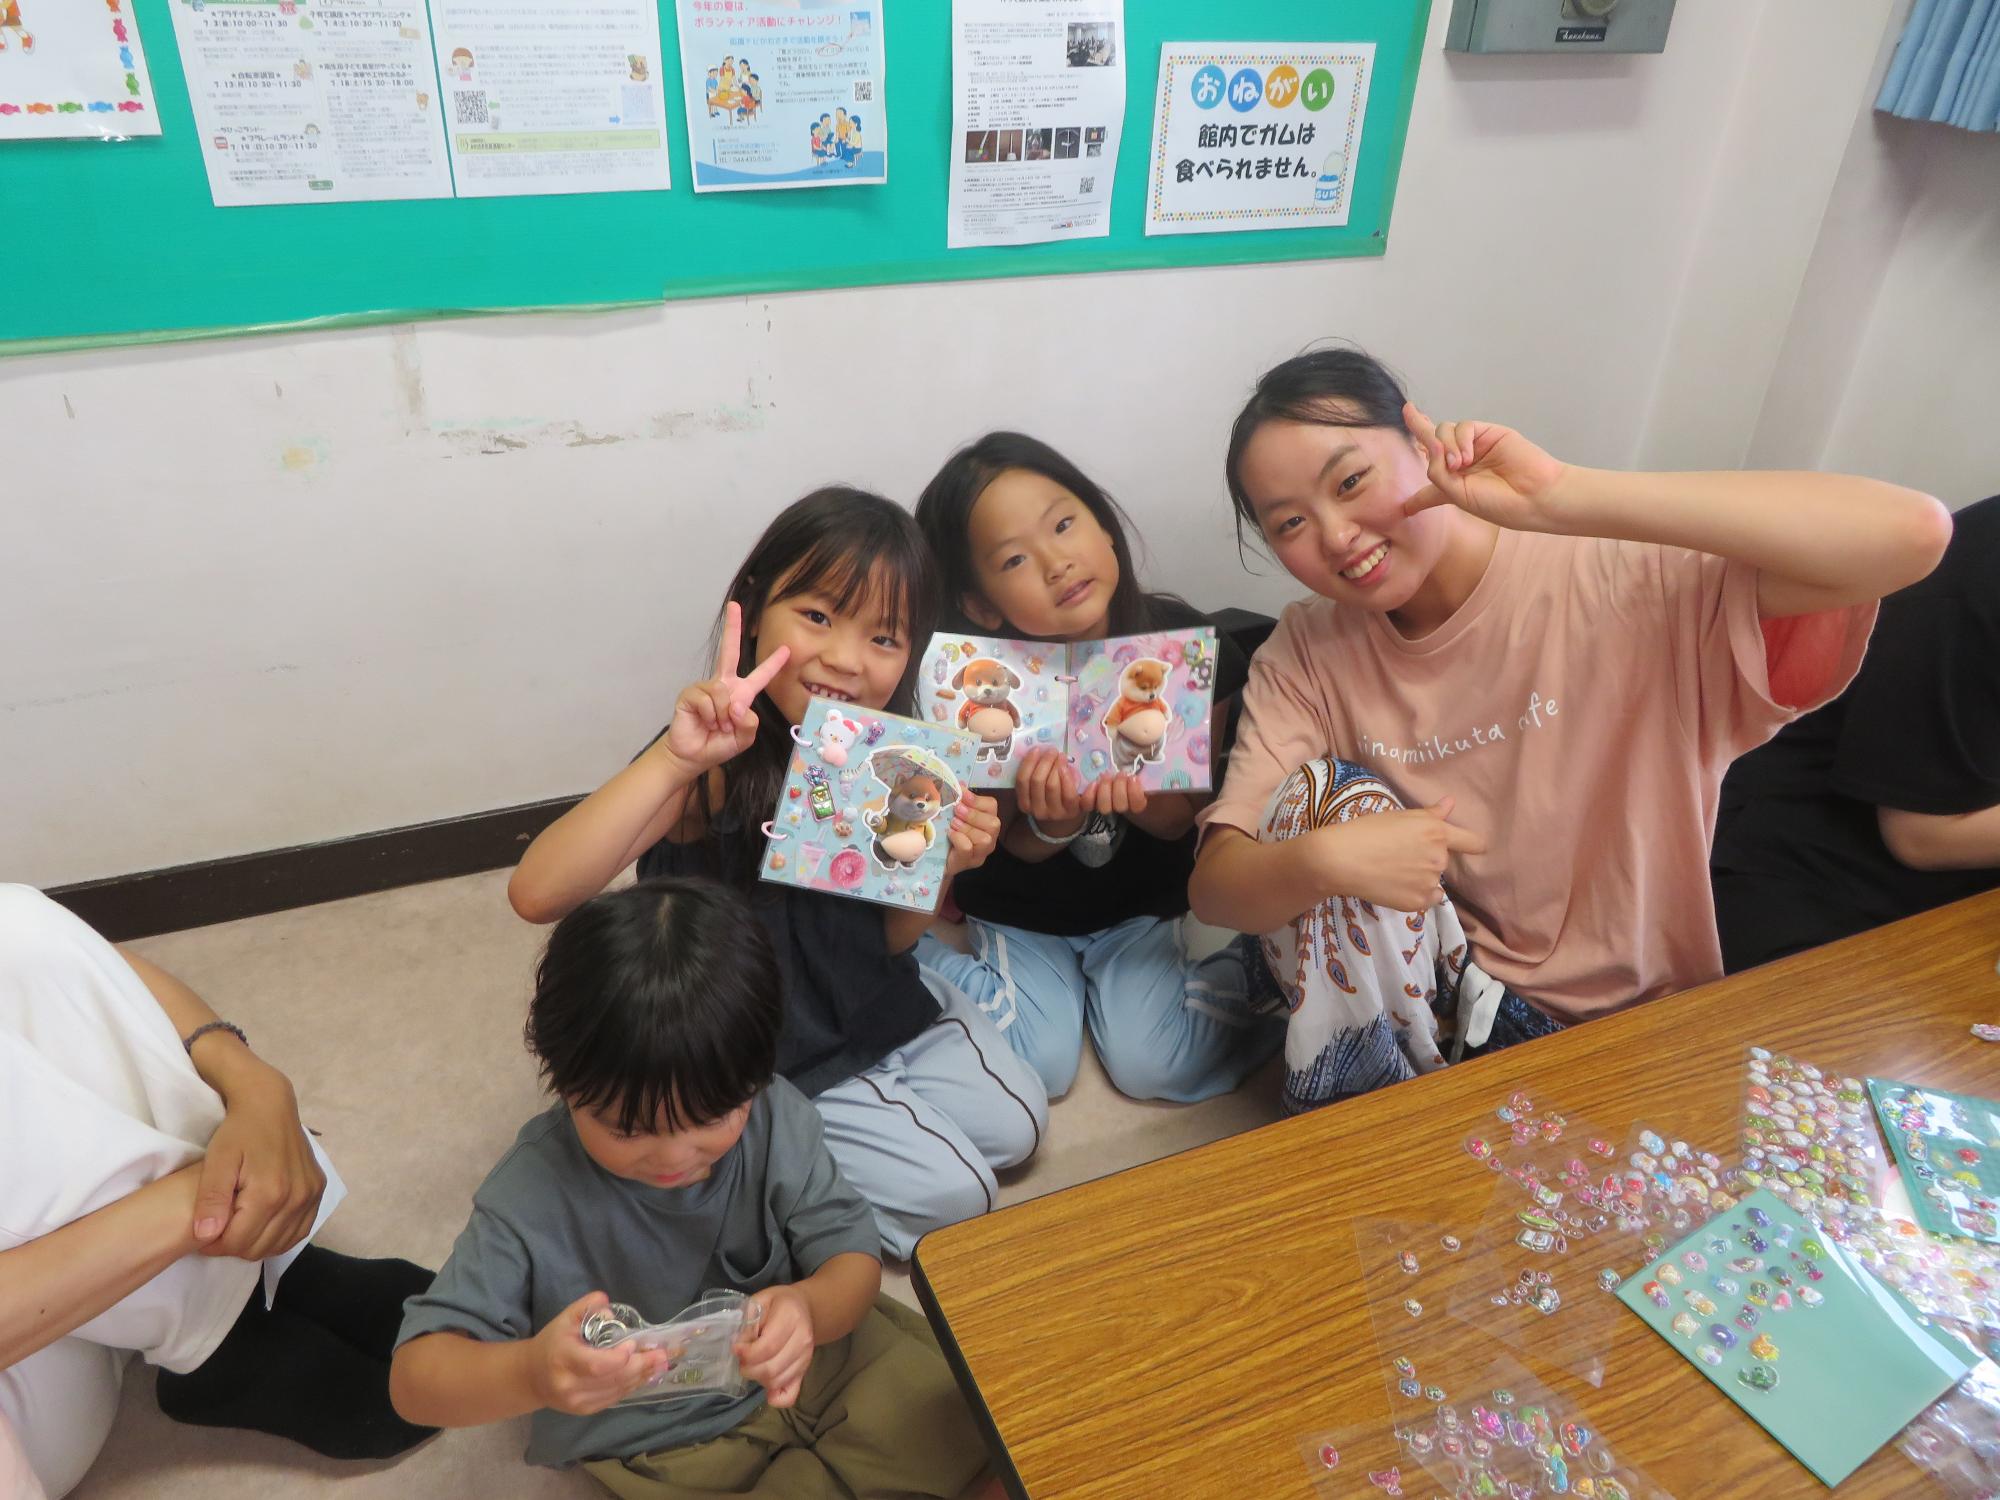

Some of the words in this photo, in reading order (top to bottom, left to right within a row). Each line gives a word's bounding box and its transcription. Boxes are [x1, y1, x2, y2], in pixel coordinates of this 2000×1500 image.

[1196, 72, 1329, 105] おねがい
[1198, 123, 1316, 149] 館内でガムは
[1175, 156, 1317, 183] 食べられません。
[1315, 188, 1338, 200] GUM
[1358, 723, 1506, 764] inamiikuta
[1518, 691, 1559, 728] afe
